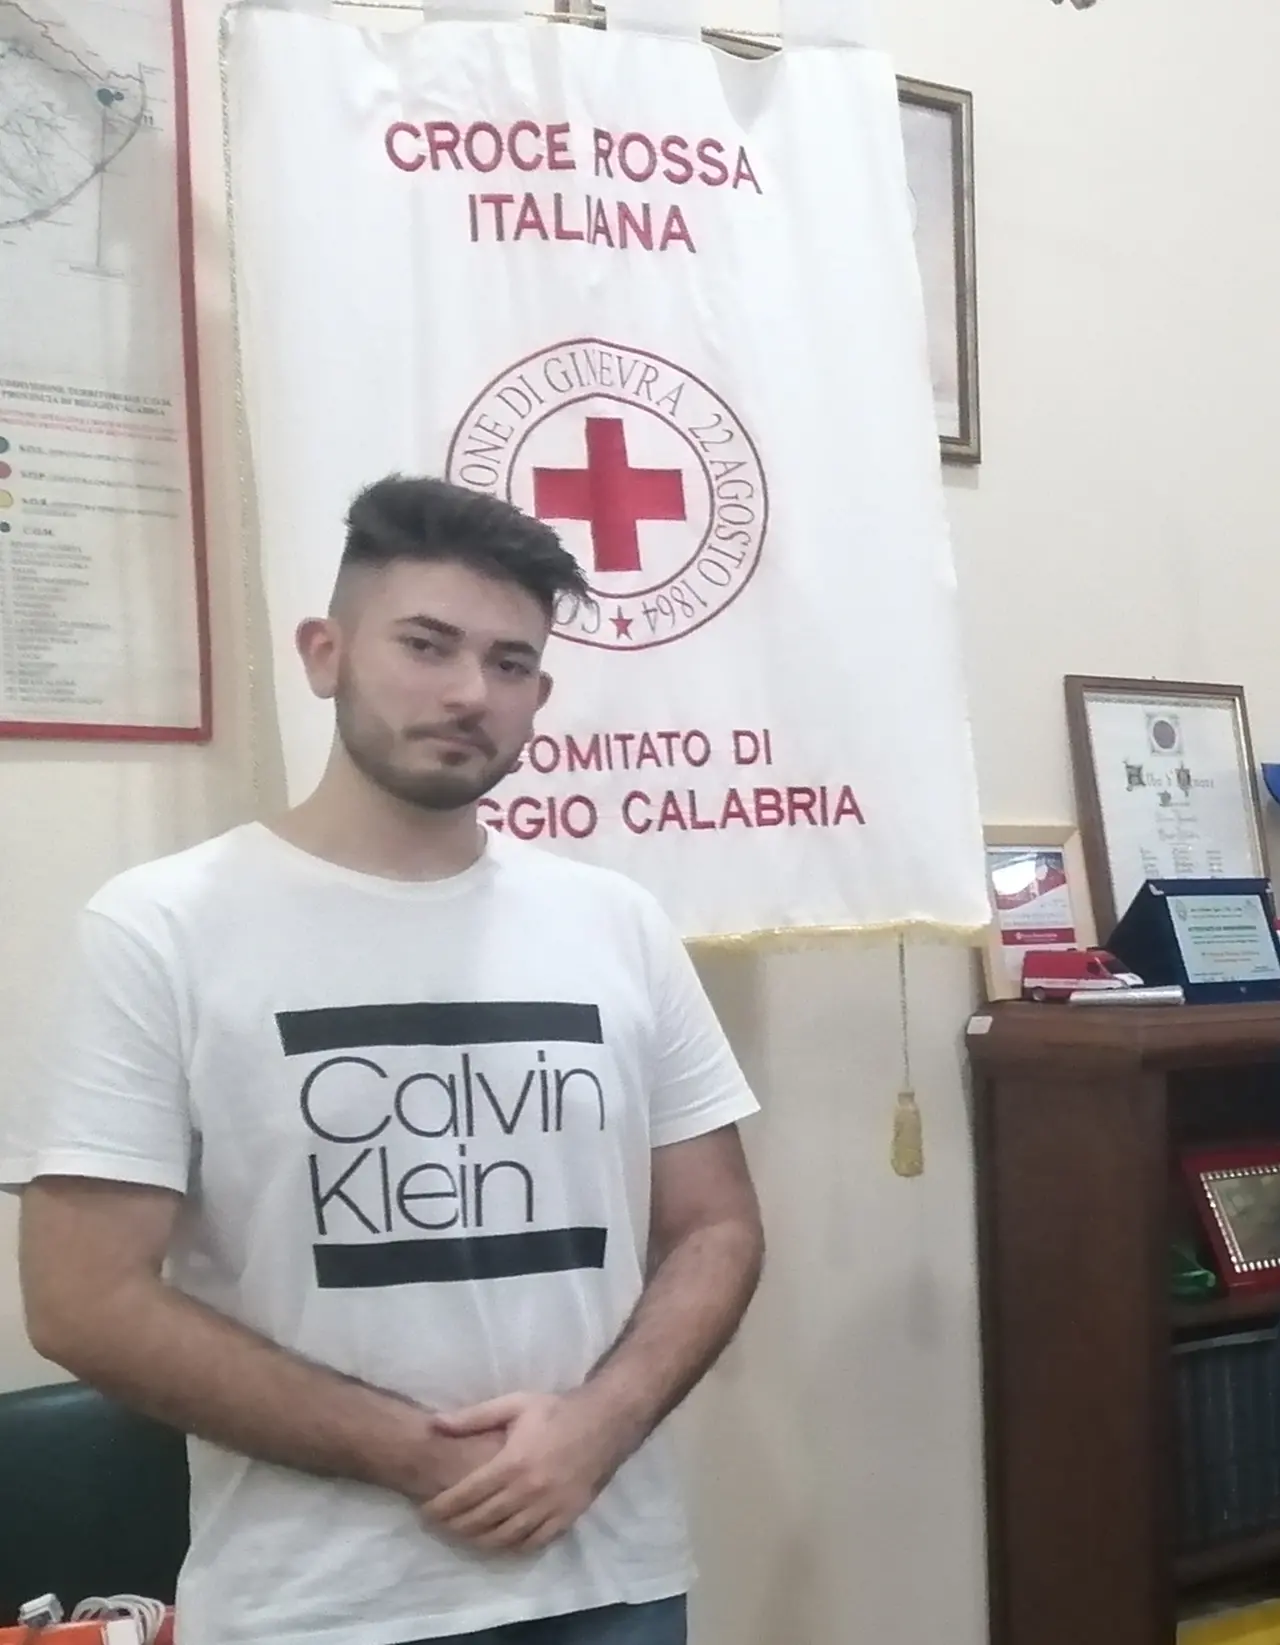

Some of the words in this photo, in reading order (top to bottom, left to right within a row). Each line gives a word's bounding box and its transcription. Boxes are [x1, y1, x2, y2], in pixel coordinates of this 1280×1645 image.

[384, 119, 577, 173] CROCE
[593, 126, 763, 196] ROSSA
[468, 191, 697, 254] ITALIANA
[495, 374, 546, 419] DI
[543, 349, 686, 418] GINEVRA
[688, 412, 734, 453] 22
[696, 458, 756, 588] AGOSTO
[642, 579, 709, 635] 1864
[512, 729, 711, 774] OMITATO
[733, 728, 773, 766] DI
[476, 794, 598, 841] GGIO
[622, 784, 866, 835] CALABRIA
[300, 1049, 605, 1144] Calvin
[308, 1143, 534, 1236] Klein
